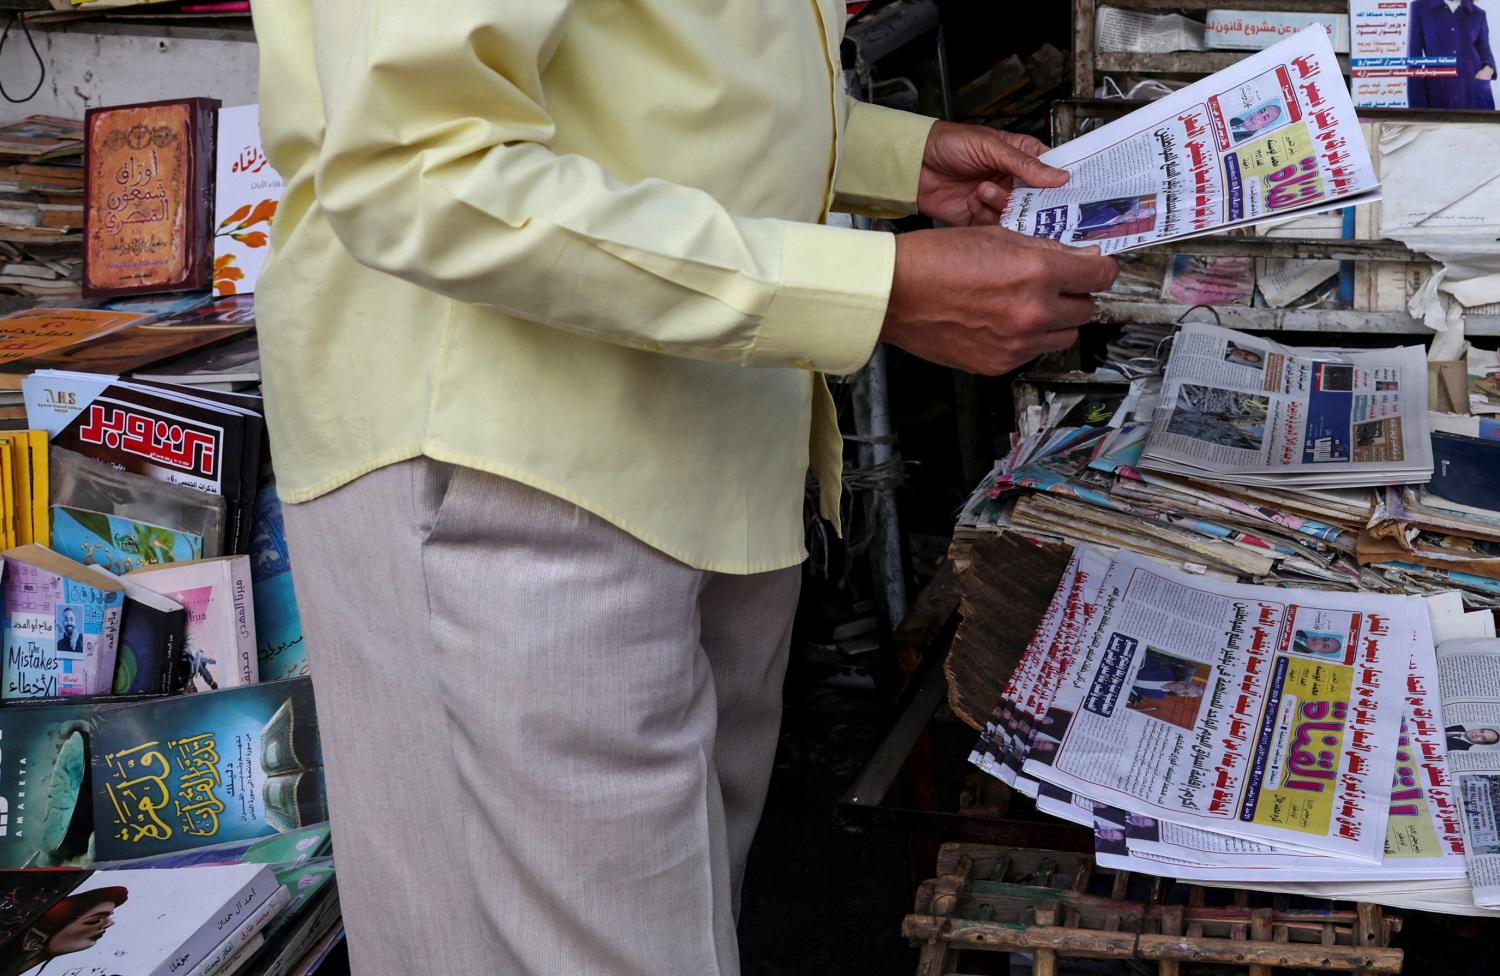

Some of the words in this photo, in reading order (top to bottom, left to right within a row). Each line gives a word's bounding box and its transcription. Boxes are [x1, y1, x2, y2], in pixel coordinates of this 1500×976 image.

[1215, 20, 1243, 37] قانون
[1244, 21, 1276, 36] مشروع
[1257, 602, 1279, 627] الأسعار
[1365, 613, 1389, 636] المقبل
[9, 648, 58, 670] Mistakes
[28, 641, 39, 654] The
[1361, 636, 1379, 663] ديسمبر
[8, 672, 57, 698] الأخطاء
[1357, 663, 1383, 688] التجار
[1355, 687, 1374, 697] مع
[1286, 697, 1350, 795] القناة
[1349, 724, 1374, 752] الأسعار
[225, 762, 236, 797] دليلك
[16, 757, 27, 837] AMARETA
